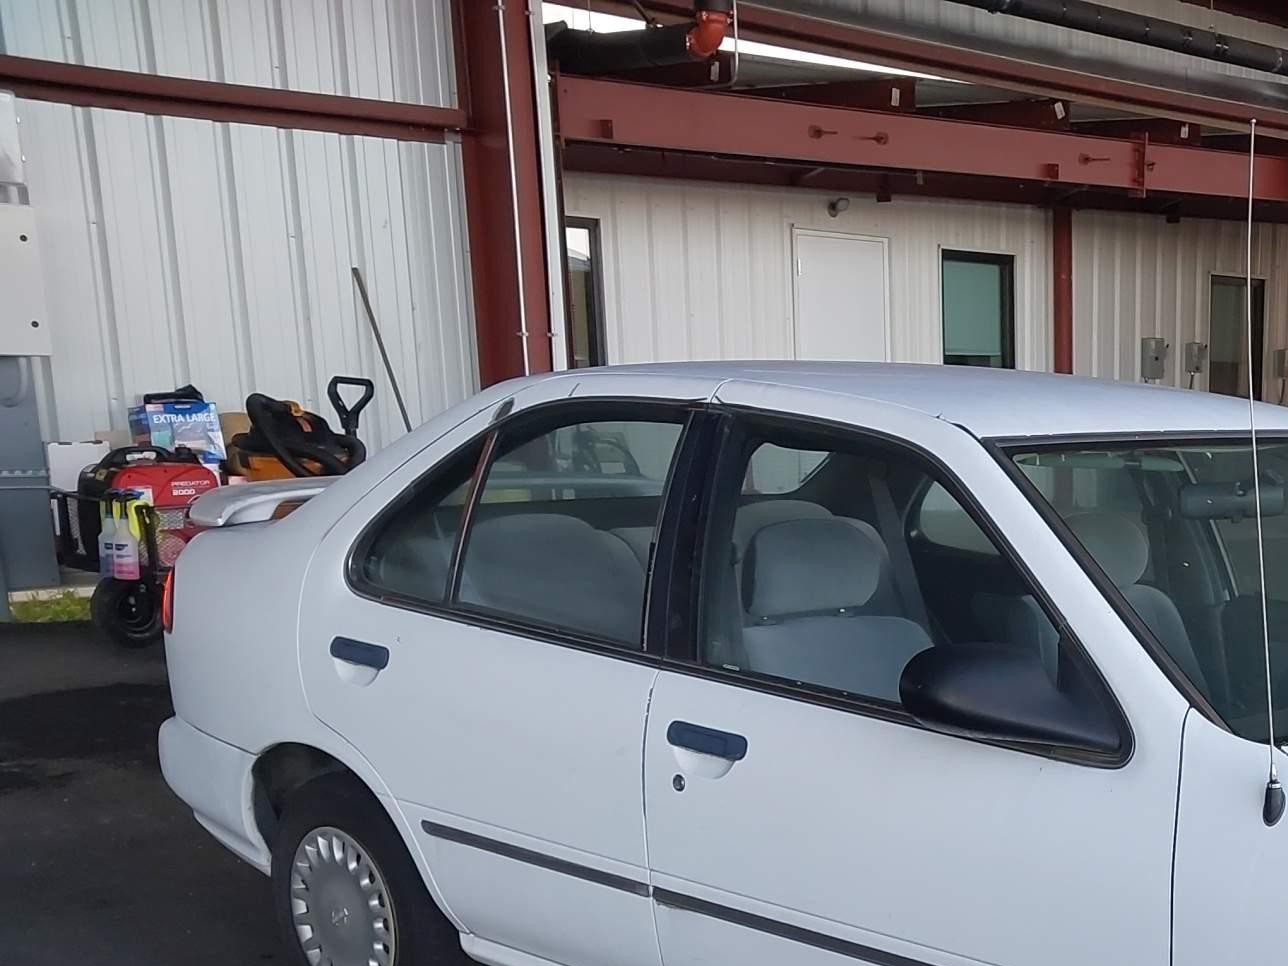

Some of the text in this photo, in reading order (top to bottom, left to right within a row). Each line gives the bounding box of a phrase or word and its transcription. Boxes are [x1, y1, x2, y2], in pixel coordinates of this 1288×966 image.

[153, 412, 217, 424] EXTRA LARGE
[172, 488, 196, 496] 2000
